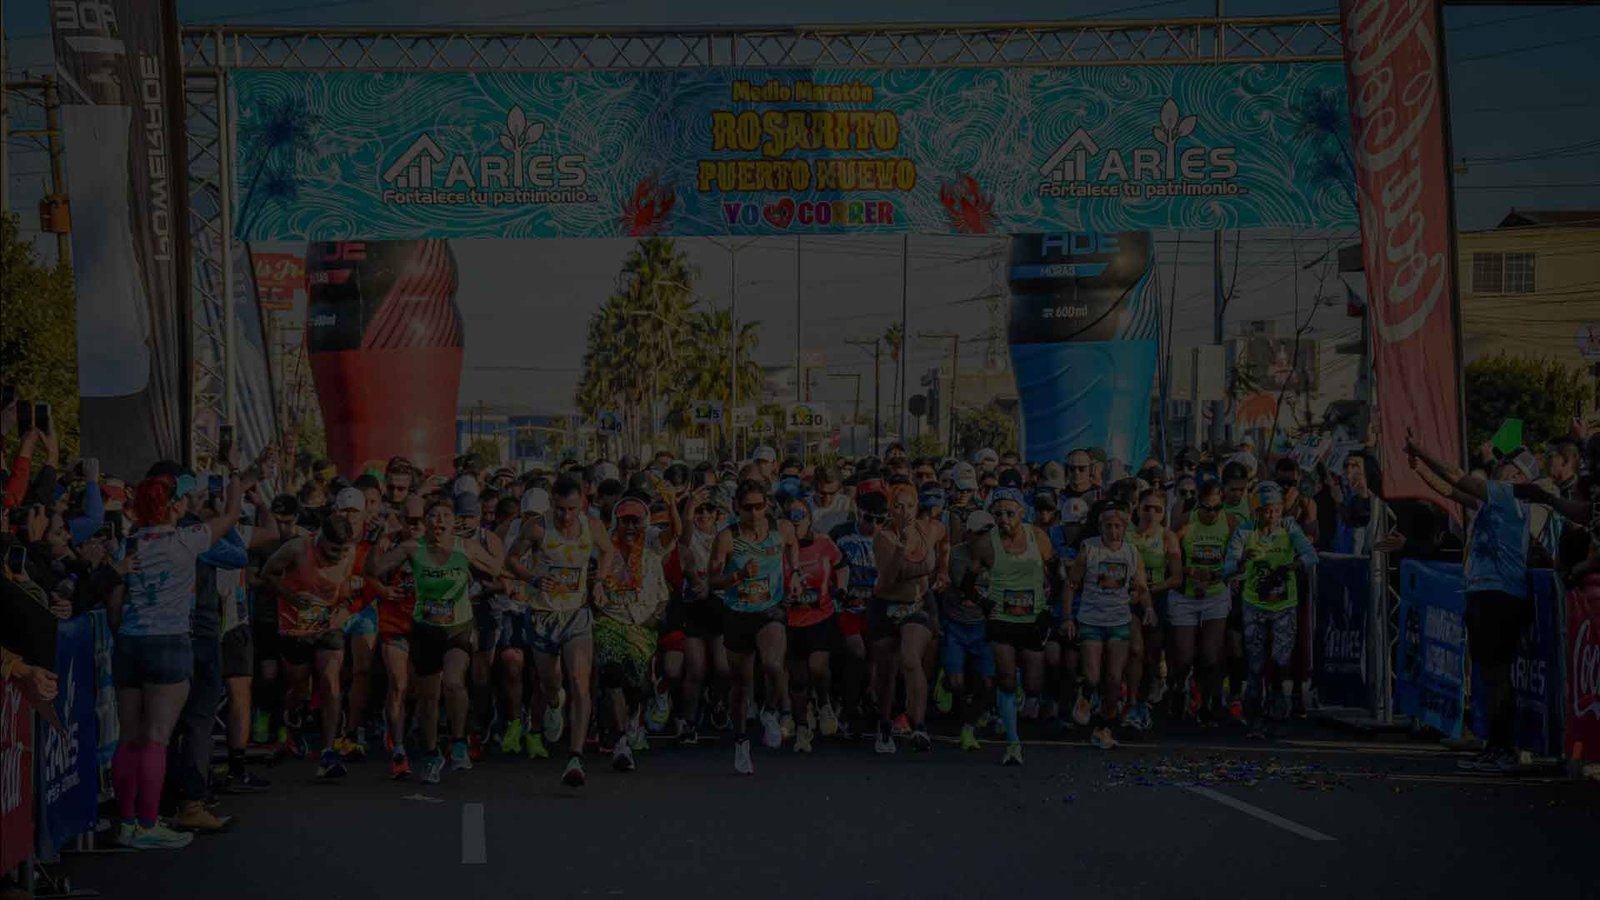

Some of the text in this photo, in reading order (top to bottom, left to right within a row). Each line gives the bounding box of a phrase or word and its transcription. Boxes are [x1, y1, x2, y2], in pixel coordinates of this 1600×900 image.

[732, 79, 874, 102] Medio Maratón
[711, 109, 899, 157] ROSARITO
[444, 142, 587, 188] ARIES
[1098, 137, 1239, 181] ARIES
[698, 159, 917, 193] PUERTO NUEVO
[1039, 180, 1240, 199] Fortalece tu patrimonio
[383, 188, 588, 207] Fortalece tu patrimonio
[723, 201, 896, 226] YO CORRER
